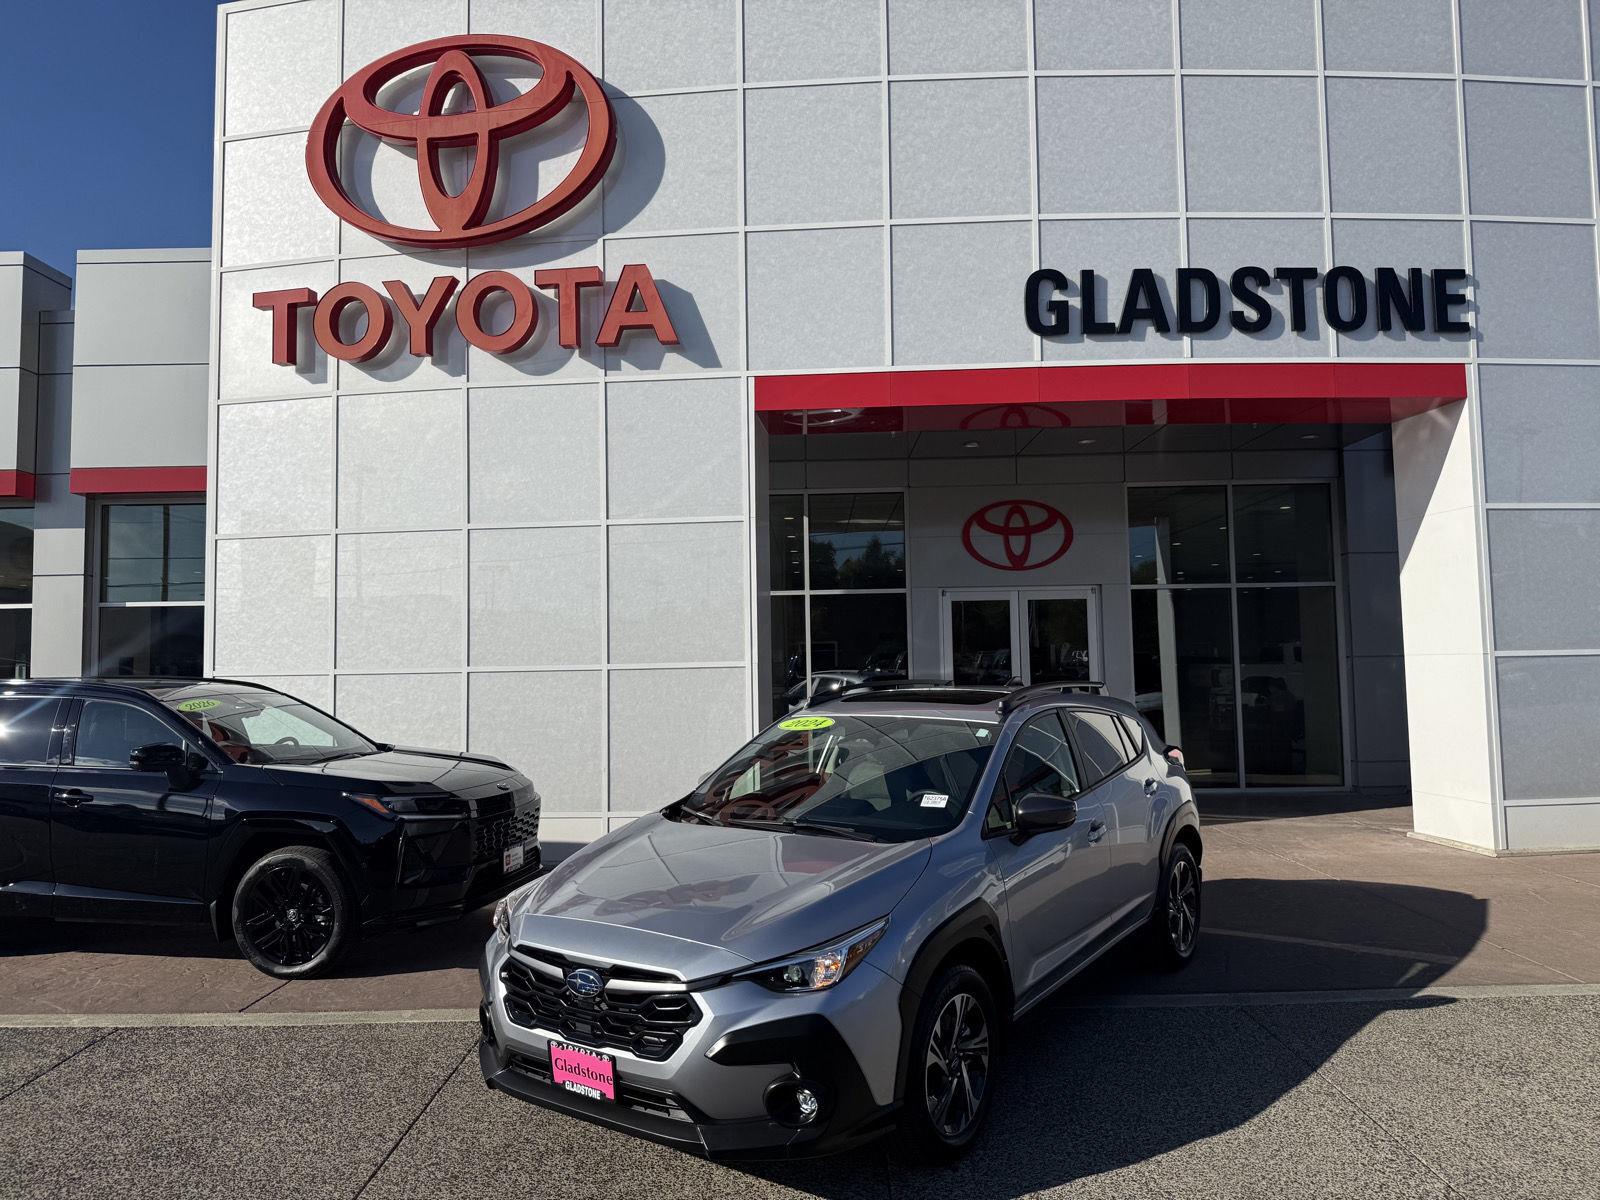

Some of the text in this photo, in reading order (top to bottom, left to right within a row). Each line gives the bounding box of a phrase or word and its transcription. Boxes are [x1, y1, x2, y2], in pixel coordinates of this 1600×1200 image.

[1023, 265, 1471, 336] GLADSTONE
[252, 263, 681, 367] TOYOTA
[185, 700, 216, 710] 2026
[554, 1057, 613, 1085] Gladstone
[565, 1080, 601, 1100] GLADSTONE
